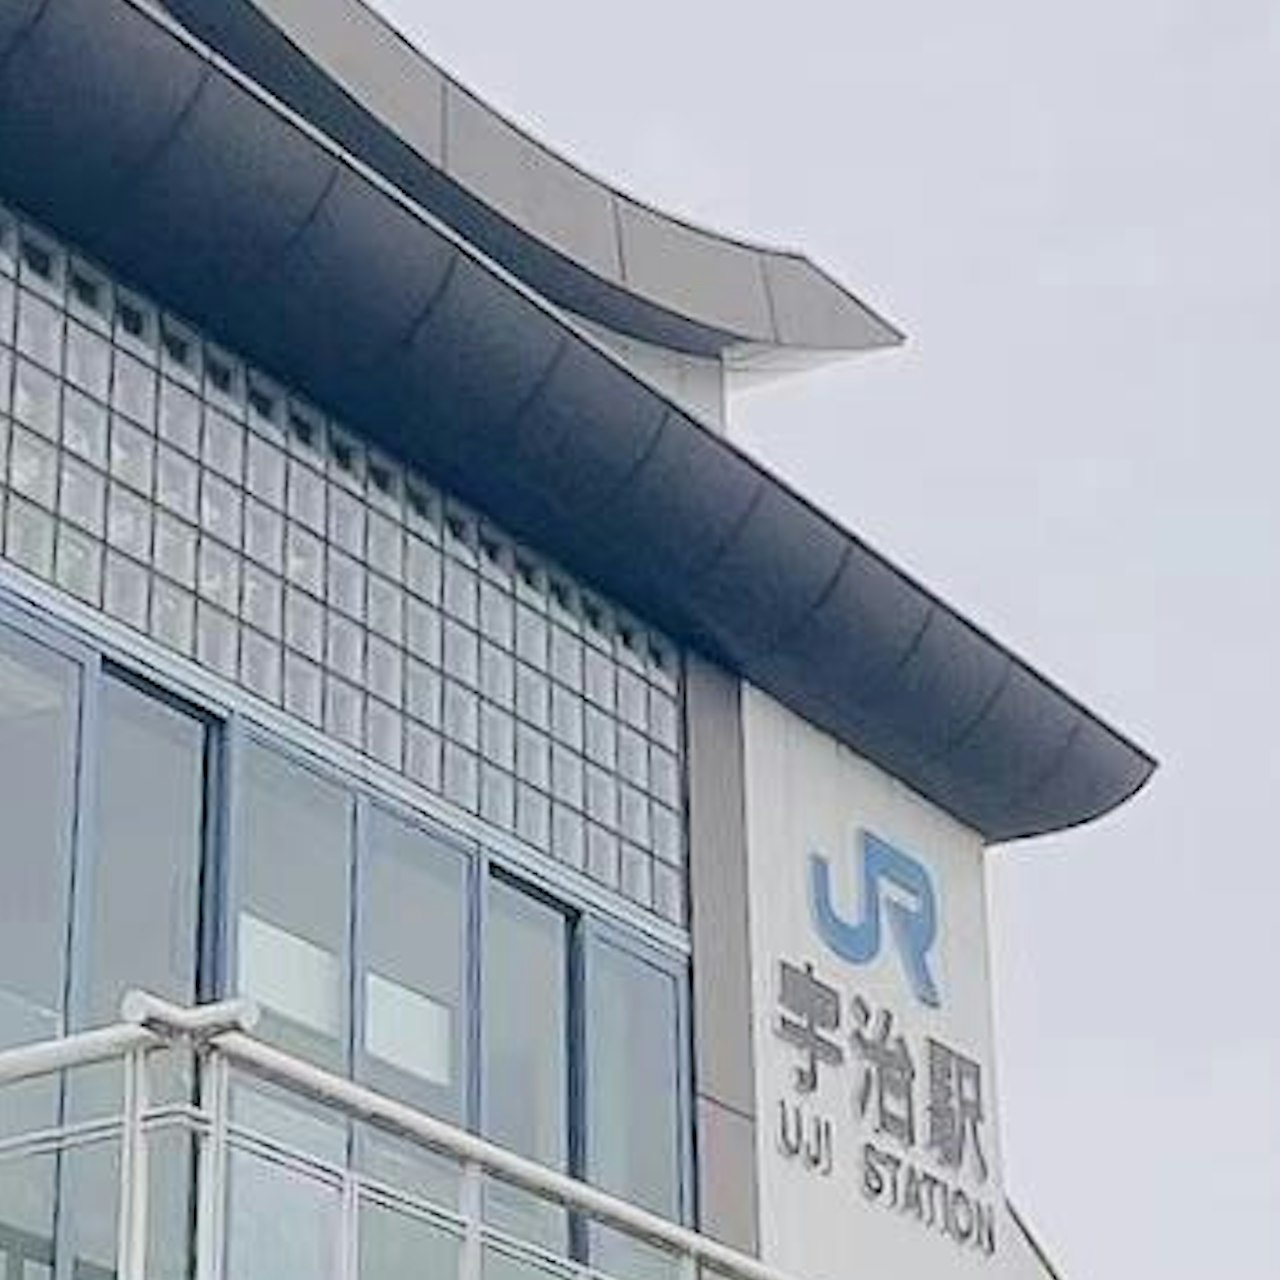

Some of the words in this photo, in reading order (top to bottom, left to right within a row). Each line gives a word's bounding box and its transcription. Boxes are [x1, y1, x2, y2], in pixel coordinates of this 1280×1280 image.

[809, 829, 940, 1008] JR
[773, 959, 988, 1183] 宇治駅
[777, 1100, 833, 1176] UJI
[862, 1142, 996, 1254] STATION
